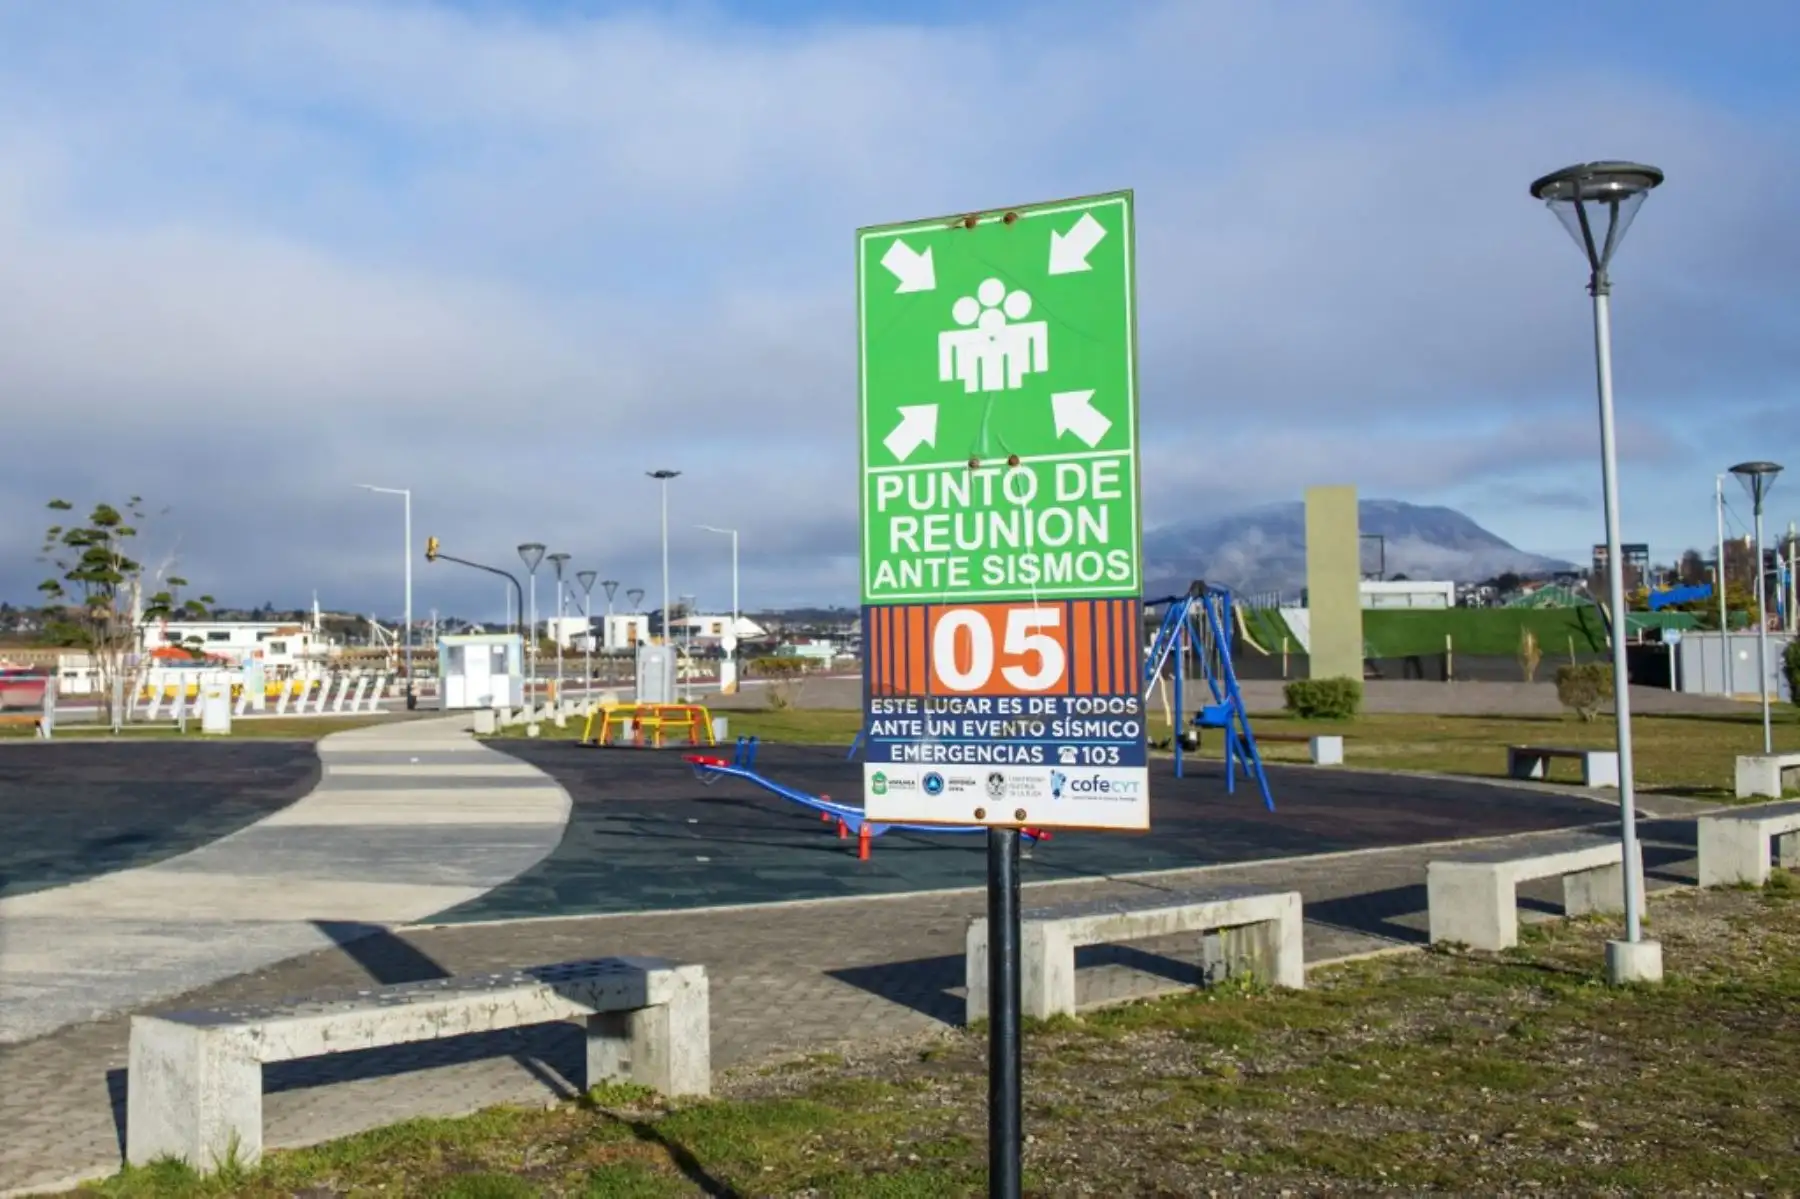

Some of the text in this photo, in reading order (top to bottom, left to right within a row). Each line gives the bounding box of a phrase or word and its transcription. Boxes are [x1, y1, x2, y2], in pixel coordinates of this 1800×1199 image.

[877, 460, 1122, 512] PUNTO DE
[890, 504, 1109, 553] REUNION
[873, 549, 1131, 590] ANTE SISMOS
[933, 607, 1066, 692] 05
[871, 697, 1138, 715] ESTE LUGAR ES DE TODOS
[870, 716, 1140, 738] ANTE UN EVENTO SÍSMICO
[890, 744, 1120, 764] EMERGENCIAS 103
